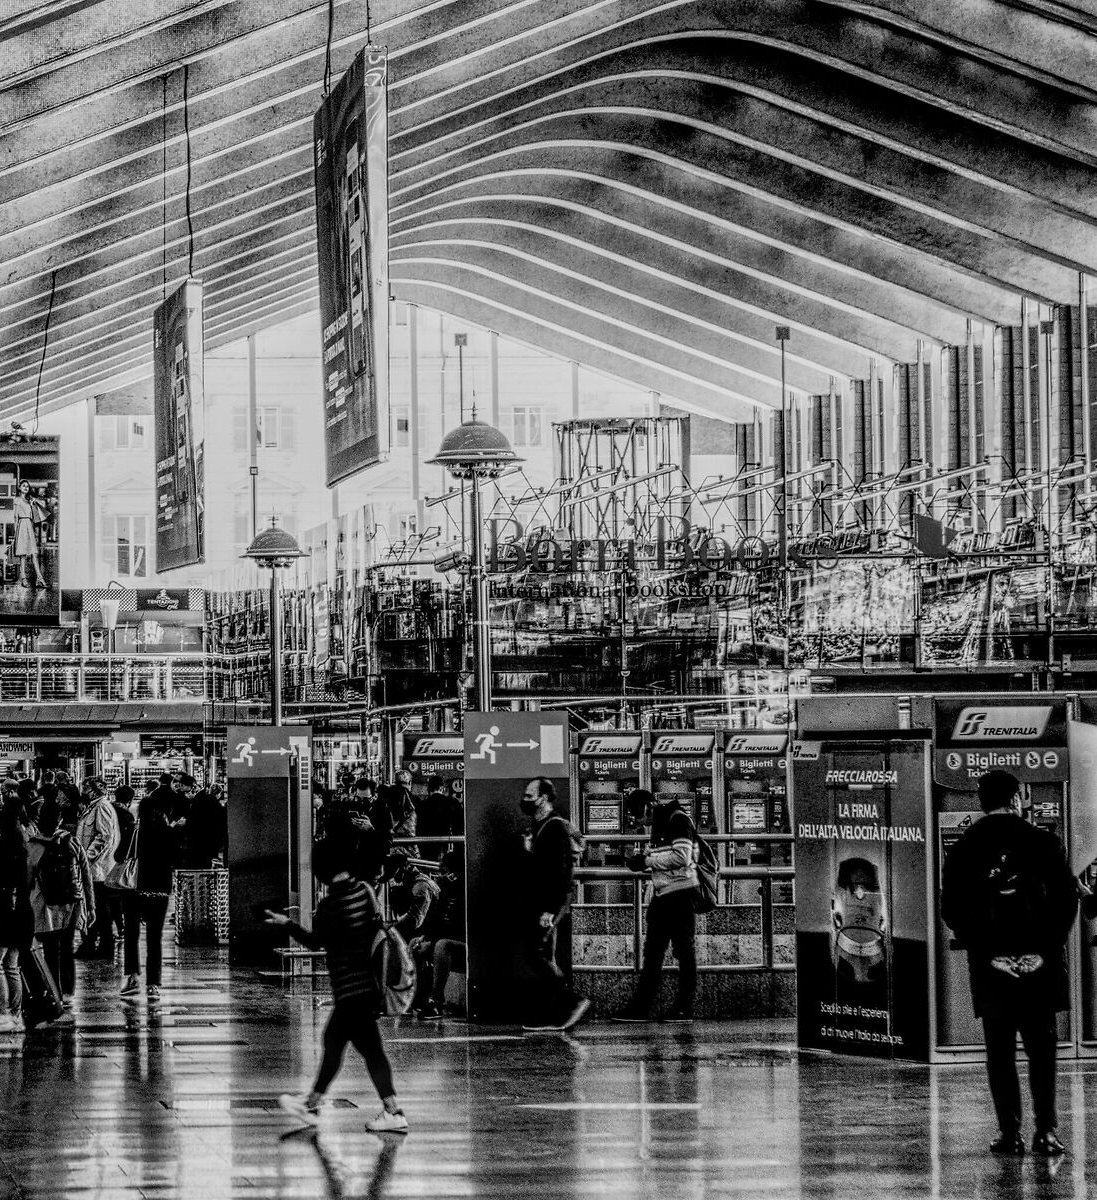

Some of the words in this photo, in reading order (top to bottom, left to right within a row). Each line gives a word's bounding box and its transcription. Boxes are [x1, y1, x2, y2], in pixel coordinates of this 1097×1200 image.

[483, 516, 638, 573] Borri
[649, 514, 839, 571] Books
[983, 727, 1038, 736] TRENITALIA
[594, 761, 628, 771] Biglietti
[666, 760, 700, 770] Biglietti
[740, 759, 773, 769] Biglietti
[966, 752, 1021, 769] Biglietti
[421, 762, 454, 772] Biglietti
[825, 770, 898, 783] FRECCIAROSSA
[838, 803, 850, 818] LA
[851, 803, 879, 819] FIRMA
[798, 823, 839, 839] DELL'ALTA
[840, 822, 880, 840] VELOCITÀ
[880, 826, 925, 842] ITALIANA.
